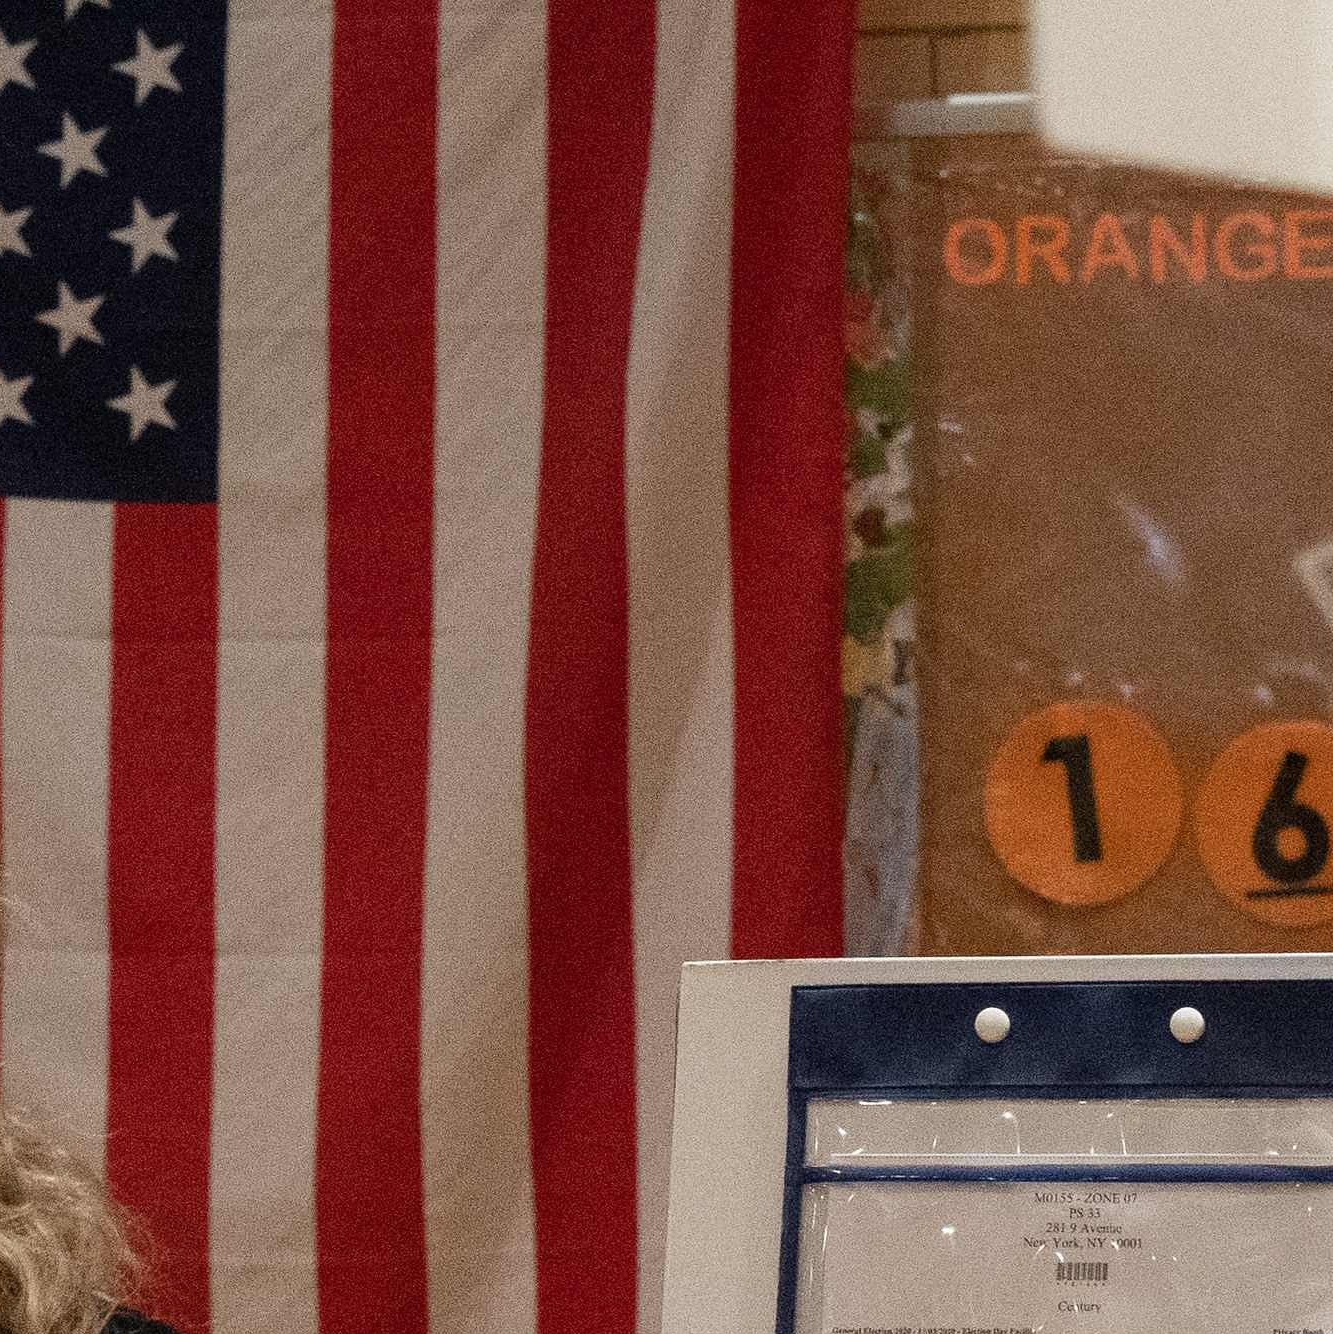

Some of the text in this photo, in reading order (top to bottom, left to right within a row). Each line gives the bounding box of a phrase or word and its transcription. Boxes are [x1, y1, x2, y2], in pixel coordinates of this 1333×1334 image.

[944, 207, 1333, 287] ORANGE
[1040, 735, 1103, 863] 1
[1251, 751, 1329, 884] 6
[1035, 1192, 1138, 1204] M0155 ZONE 07
[1069, 1207, 1101, 1219] PS 33
[1045, 1222, 1122, 1234] 281 9 Avenue
[1023, 1237, 1047, 1248] New
[1053, 1237, 1083, 1249] York,
[1087, 1237, 1106, 1248] NY
